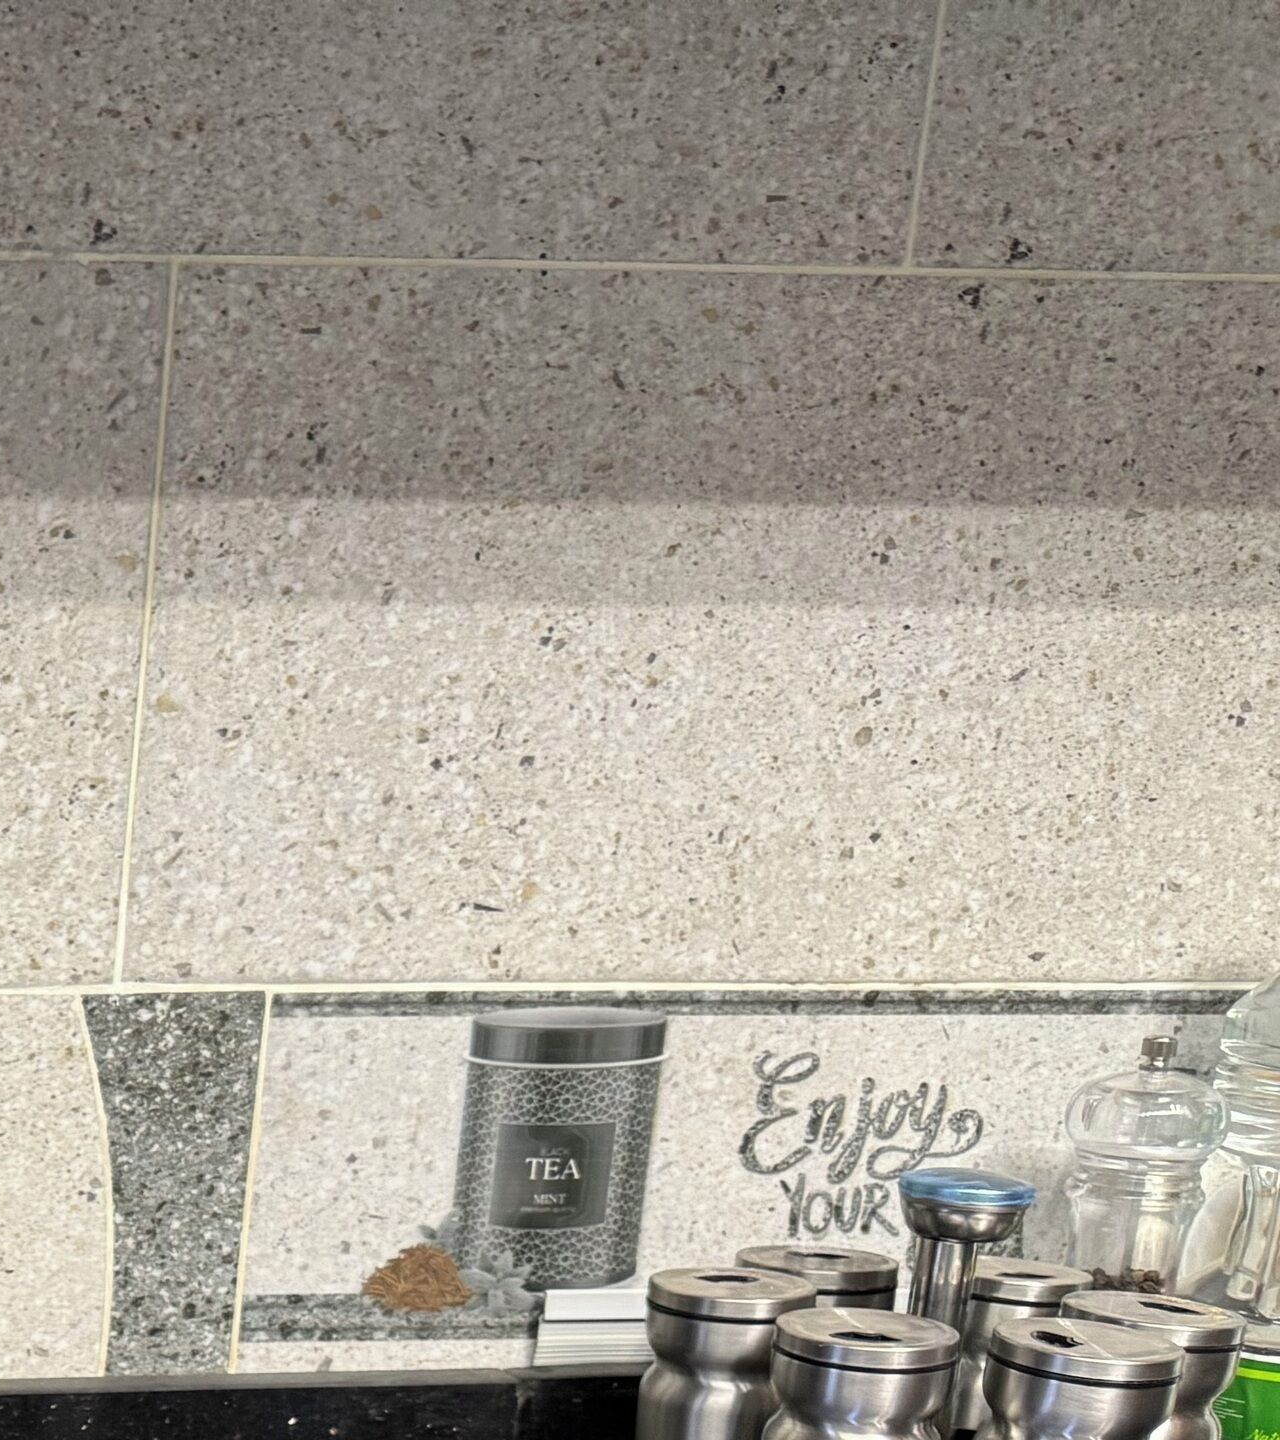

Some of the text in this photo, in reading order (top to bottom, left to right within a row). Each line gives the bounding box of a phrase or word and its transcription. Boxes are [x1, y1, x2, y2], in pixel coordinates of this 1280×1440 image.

[738, 1050, 984, 1184] Enjoy
[525, 1157, 581, 1181] TEA
[533, 1193, 567, 1205] MINT
[780, 1172, 900, 1238] YOUR
